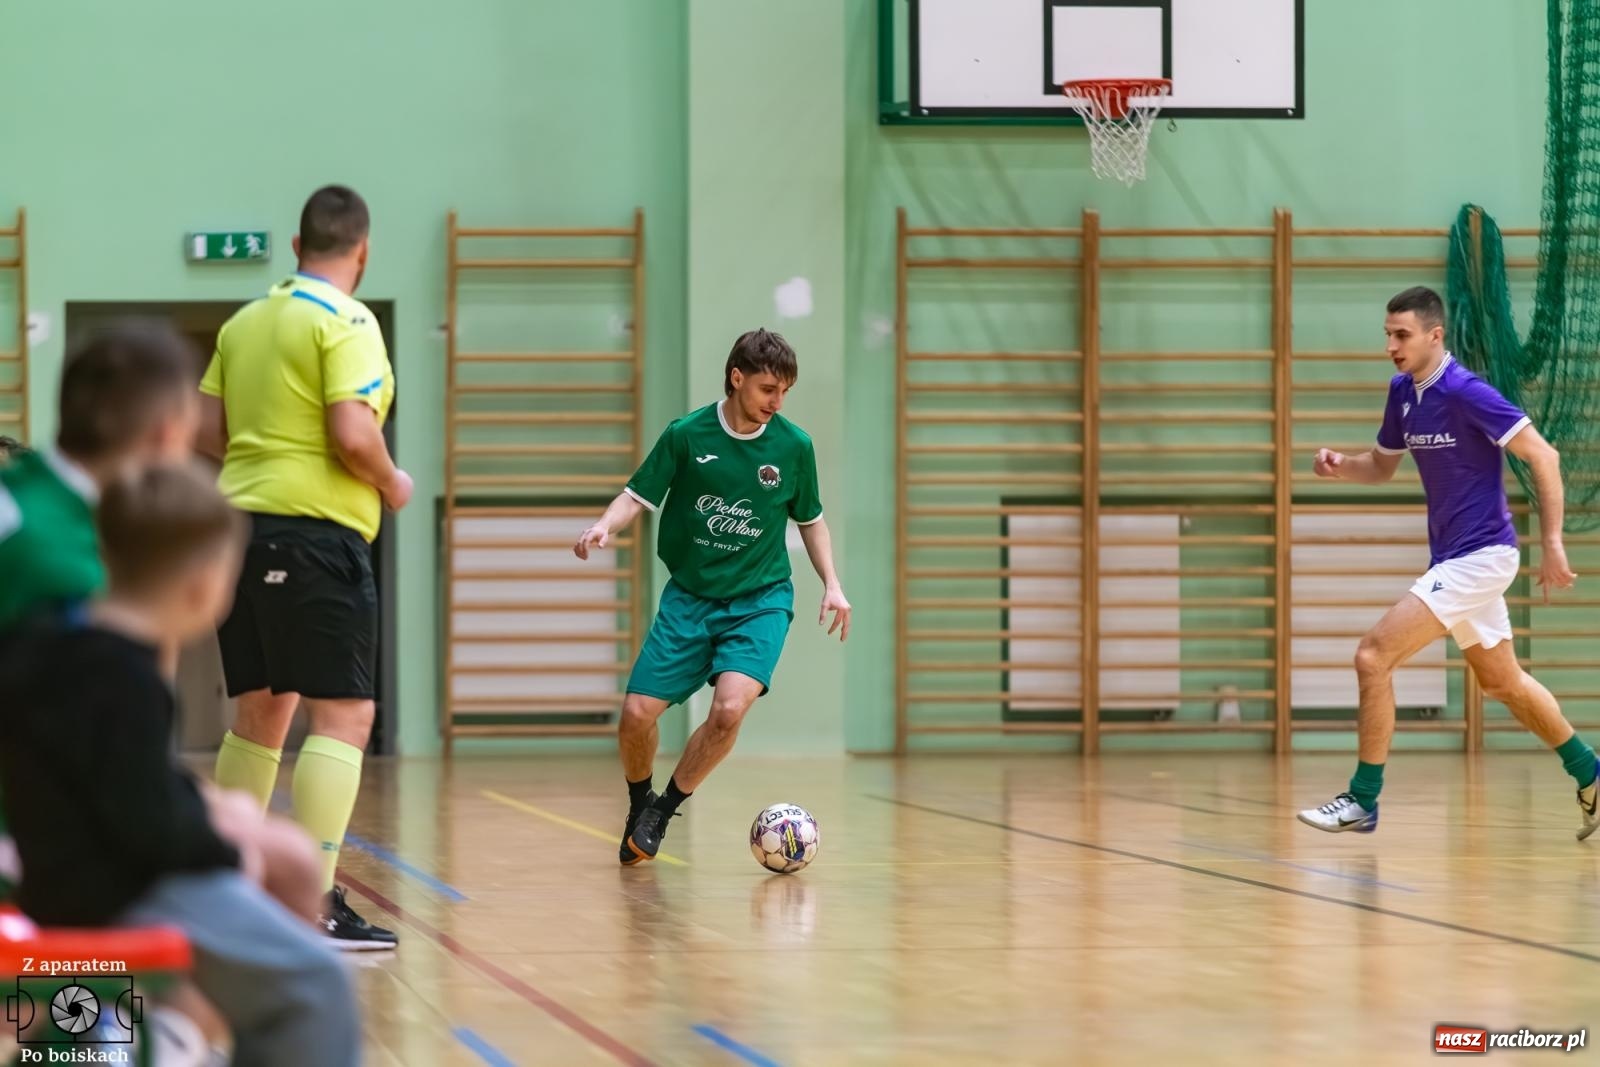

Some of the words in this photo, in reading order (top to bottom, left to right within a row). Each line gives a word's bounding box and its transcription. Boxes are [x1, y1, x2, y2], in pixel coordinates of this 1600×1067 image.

[694, 494, 753, 517] Piękne
[706, 514, 764, 541] Włosy
[764, 808, 802, 824] SELECT
